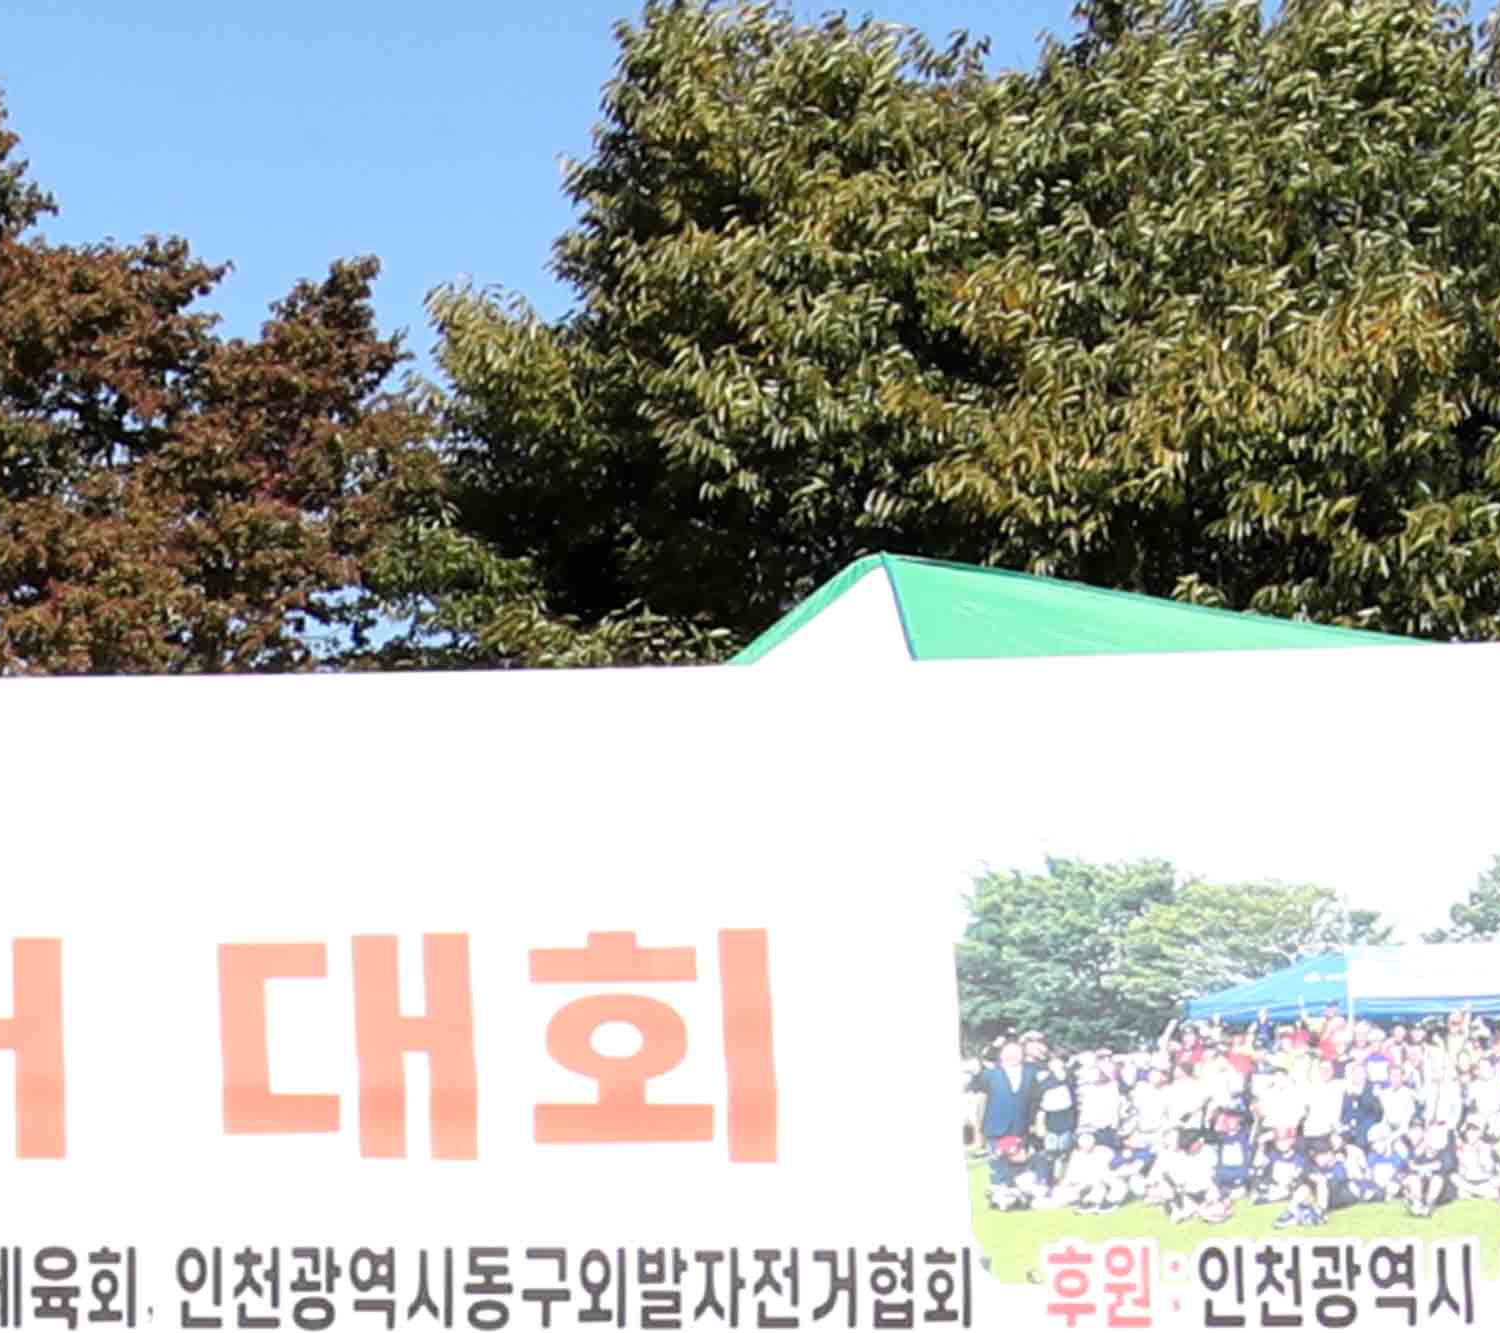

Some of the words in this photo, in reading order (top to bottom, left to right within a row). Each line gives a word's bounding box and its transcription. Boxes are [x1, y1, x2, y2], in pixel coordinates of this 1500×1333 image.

[217, 926, 779, 1165] 대회
[174, 1244, 973, 1332] 인천광역시동구외발자전거협회
[1198, 1243, 1474, 1328] 인천광역시
